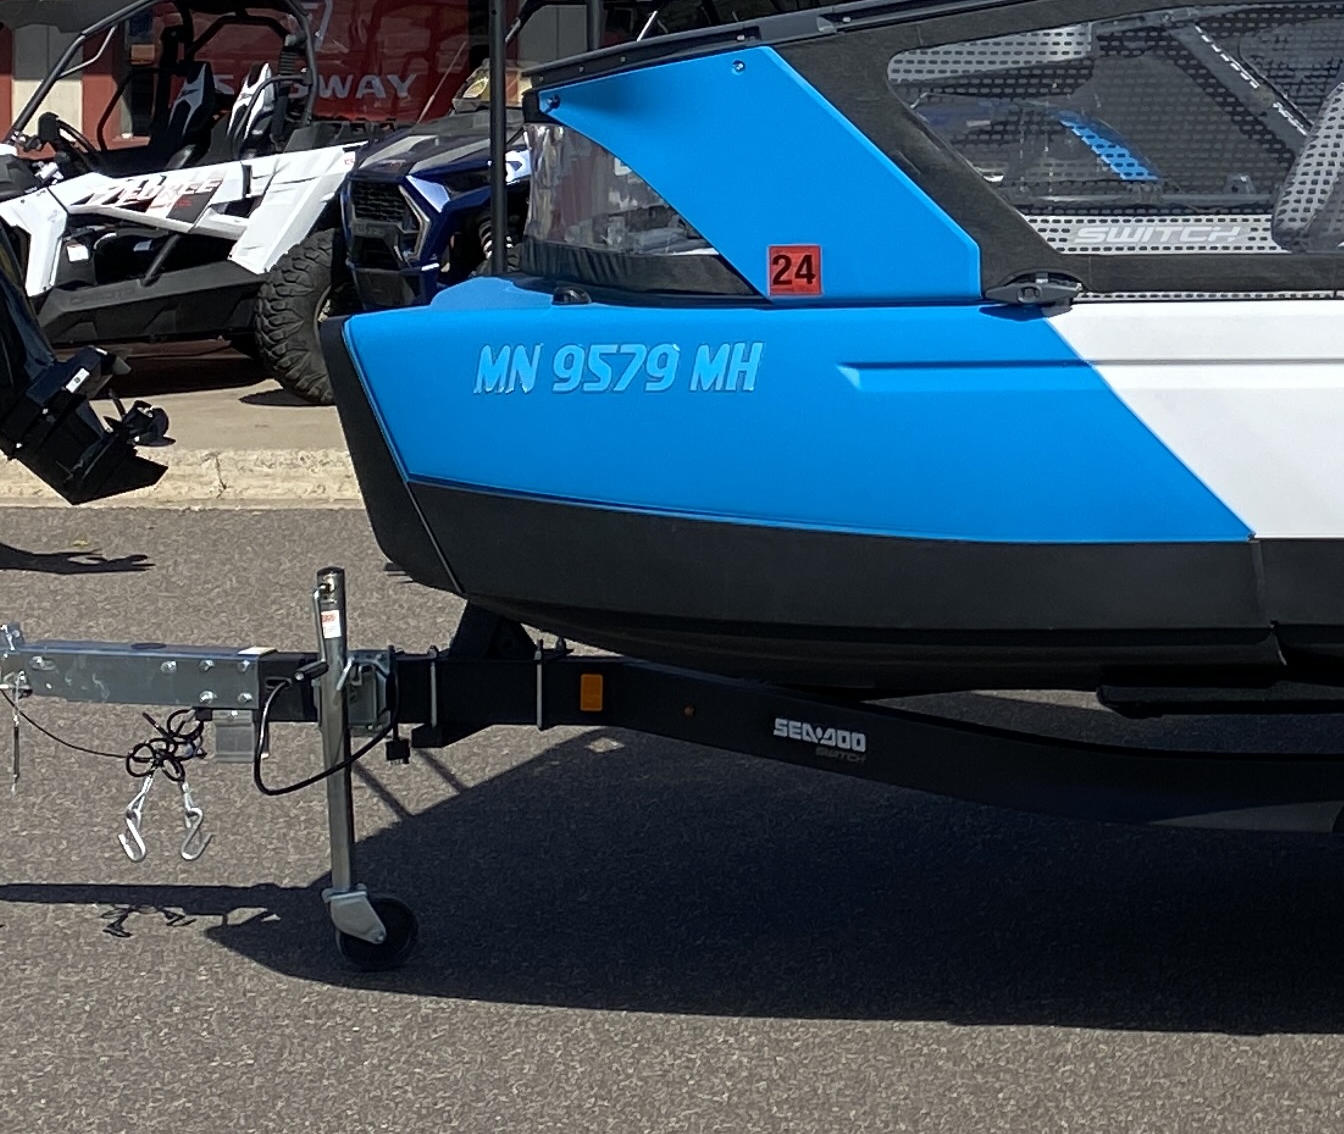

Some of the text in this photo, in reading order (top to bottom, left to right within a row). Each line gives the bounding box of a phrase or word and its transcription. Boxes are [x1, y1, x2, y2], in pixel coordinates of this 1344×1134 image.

[1074, 226, 1241, 243] SWITCH
[772, 253, 816, 285] 24
[473, 342, 765, 394] MN 9579 MH
